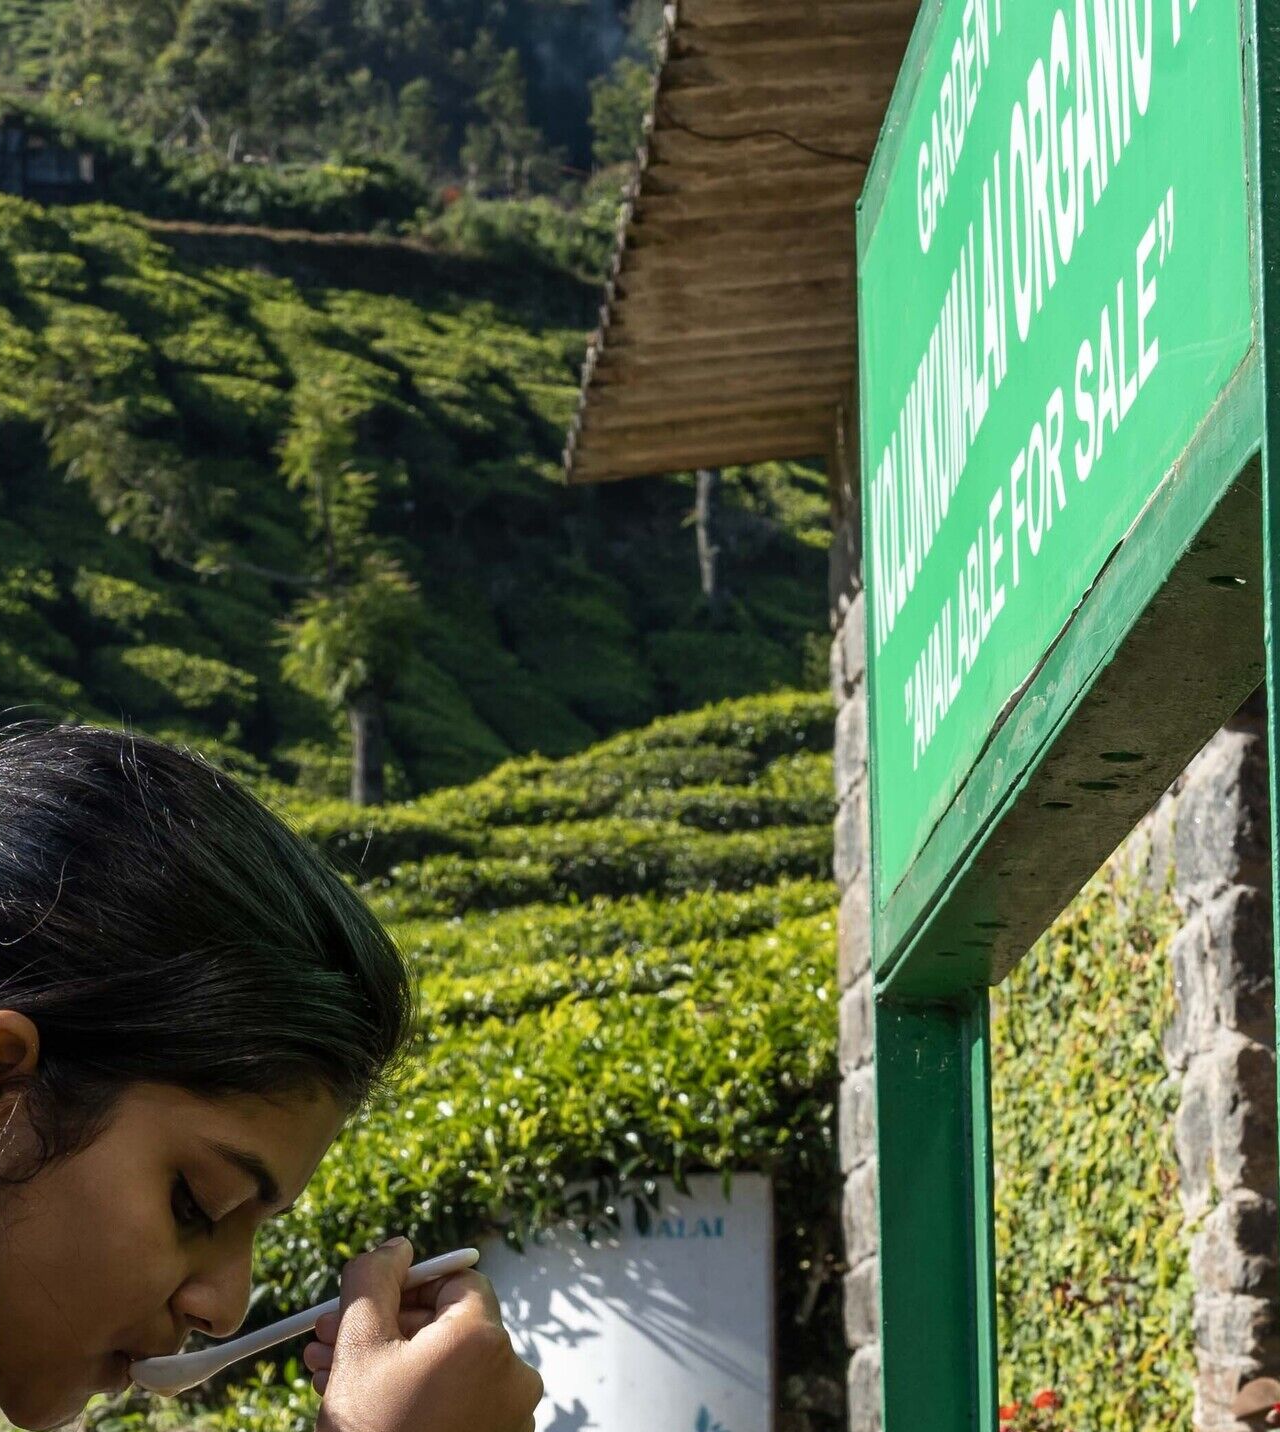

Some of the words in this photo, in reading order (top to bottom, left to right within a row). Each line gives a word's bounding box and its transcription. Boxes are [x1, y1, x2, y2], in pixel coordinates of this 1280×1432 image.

[918, 0, 989, 255] GARDEN
[870, 150, 1007, 657] KOLUKKUMALAI
[1010, 386, 1067, 589] FOR
